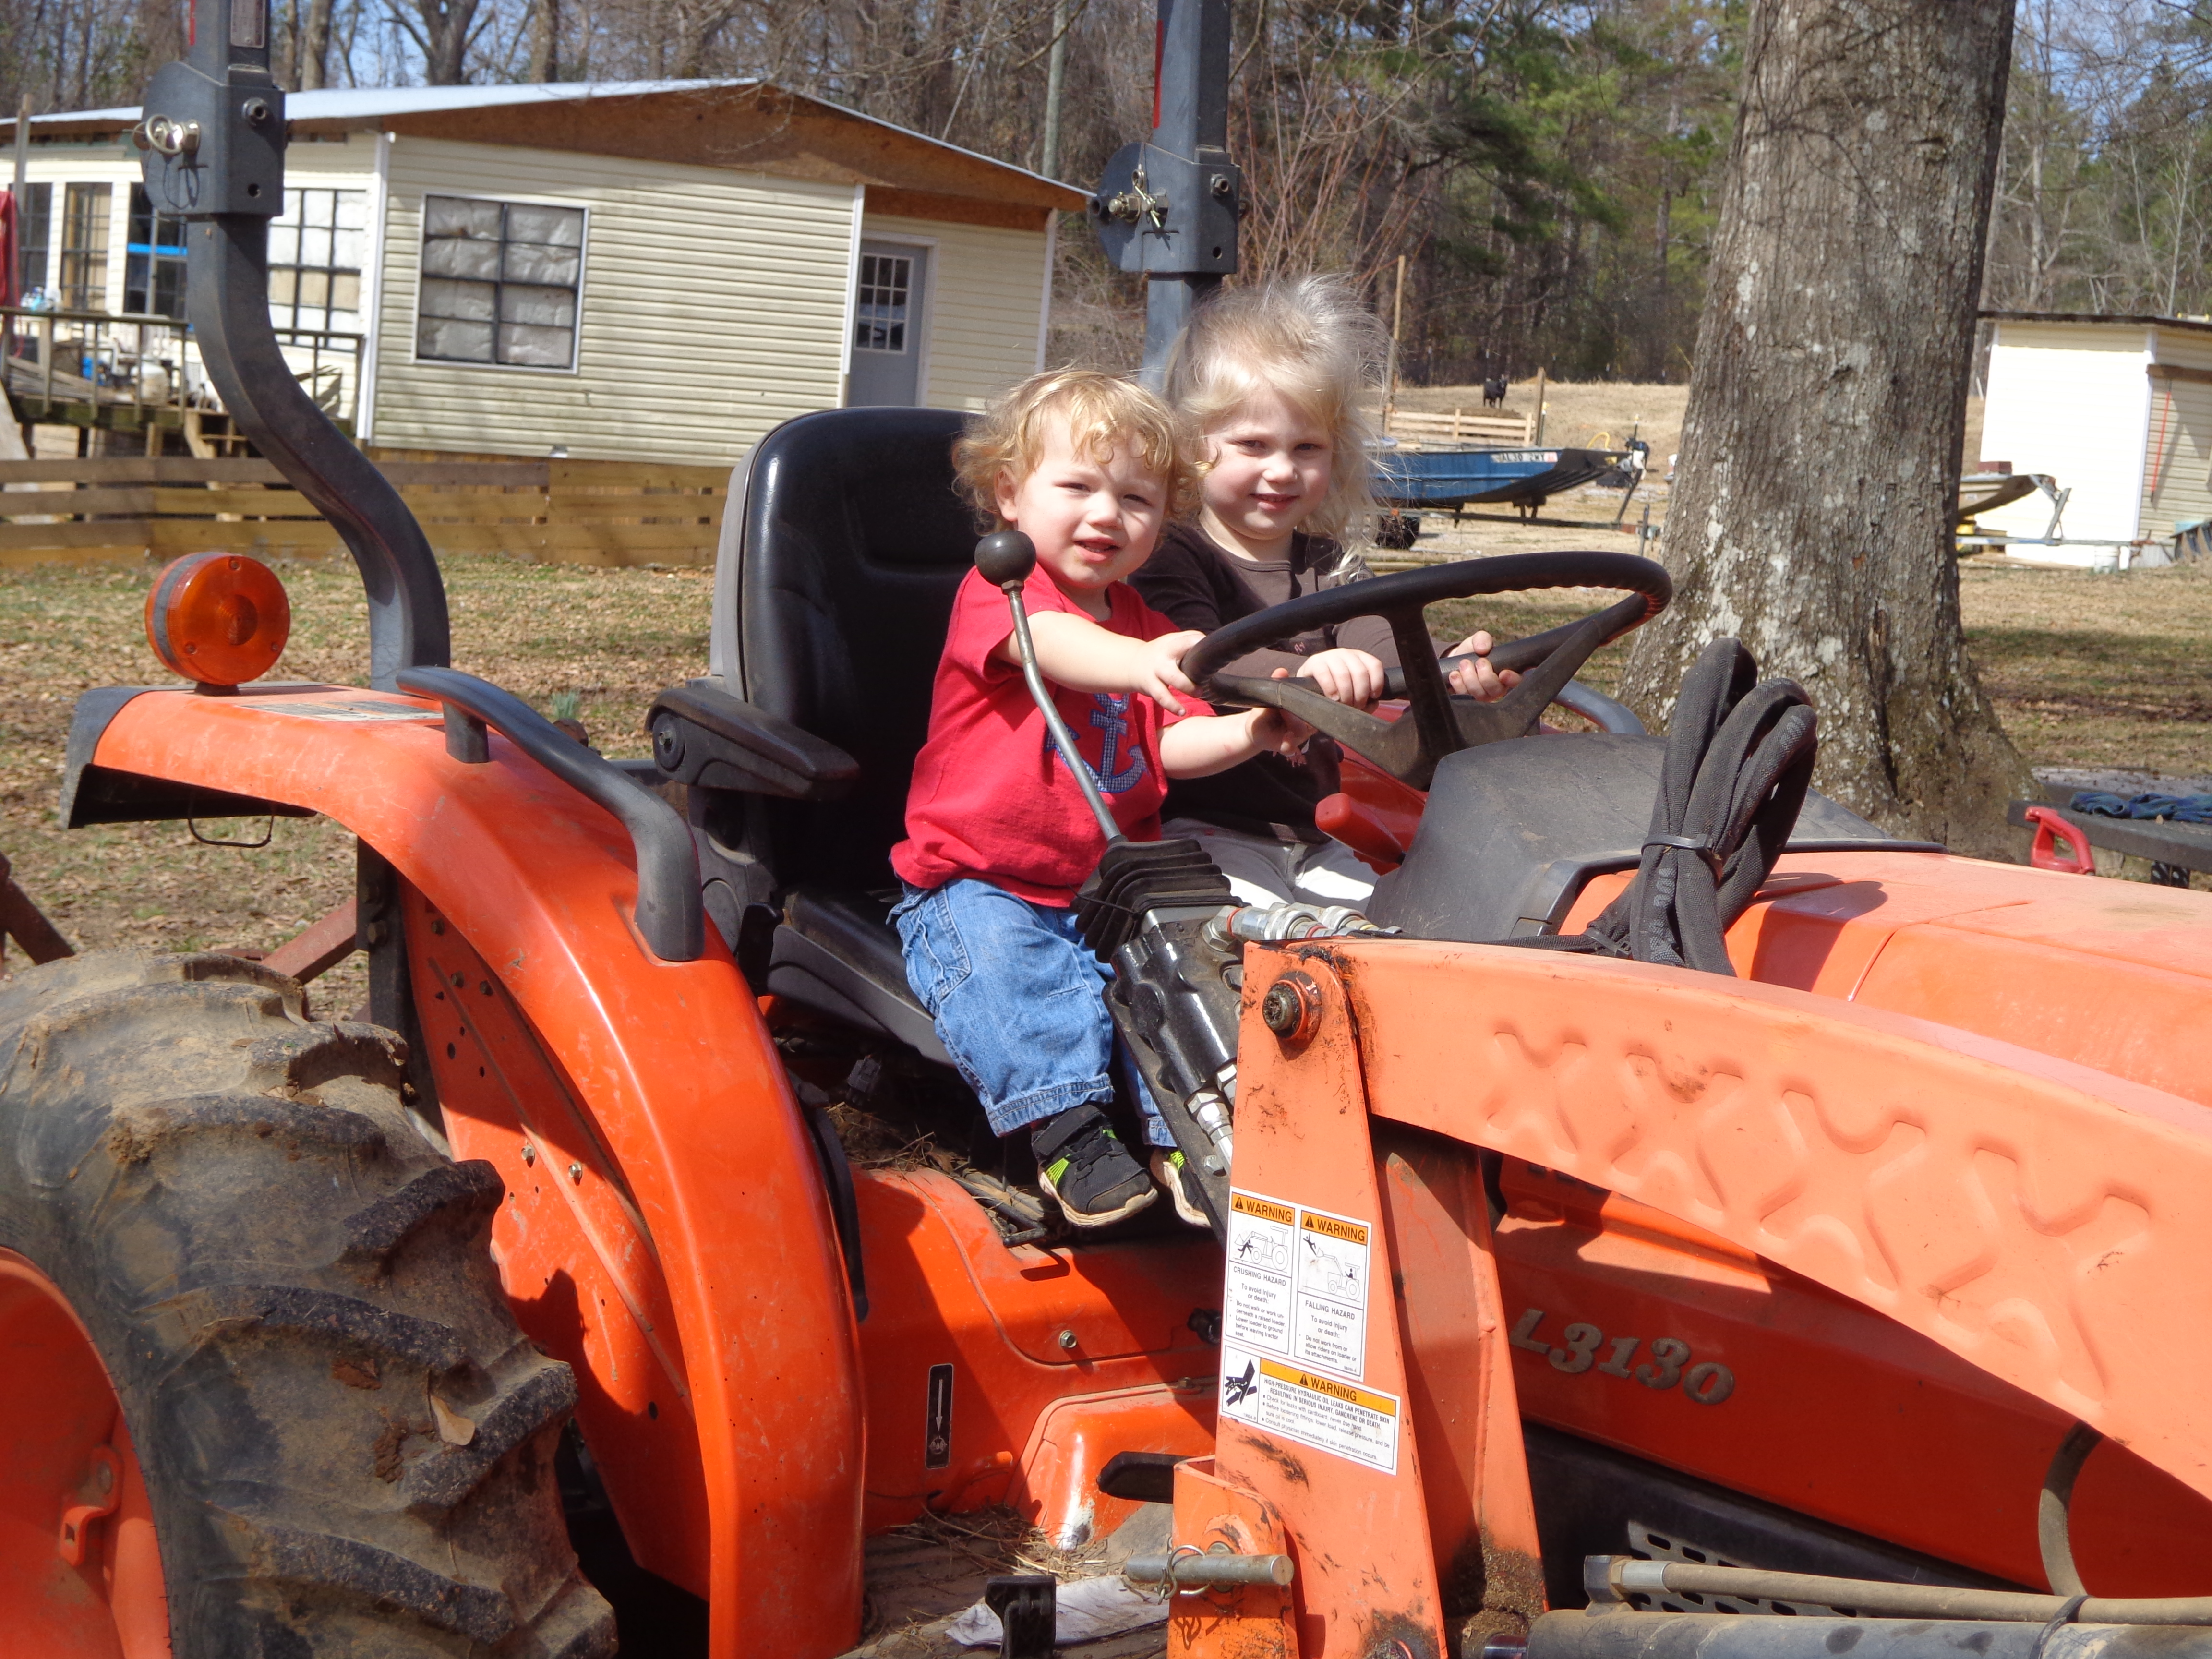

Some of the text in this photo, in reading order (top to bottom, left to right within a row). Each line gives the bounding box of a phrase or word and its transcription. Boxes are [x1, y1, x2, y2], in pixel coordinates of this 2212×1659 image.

[1246, 1200, 1292, 1223] WARNING
[1317, 1218, 1365, 1242] WARNING
[1233, 1266, 1286, 1286] CRUSHING HAZARD
[1254, 1295, 1269, 1304] death:
[1263, 1289, 1276, 1299] injury
[1237, 1309, 1253, 1318] derneath
[1305, 1300, 1355, 1320] FALLING HAZARD
[1249, 1319, 1262, 1327] loader
[1268, 1325, 1283, 1334] ground
[1250, 1327, 1263, 1337] leaving
[1265, 1332, 1278, 1340] tractor
[1324, 1329, 1340, 1338] death:
[1334, 1322, 1347, 1333] injury
[1509, 1308, 1736, 1405] L3130
[1311, 1377, 1357, 1402] WARNING
[1264, 1378, 1296, 1394] HIGH-PRESSURE
[1298, 1389, 1321, 1402] HYDRAULIC
[1331, 1400, 1343, 1408] LEAKS
[1355, 1407, 1378, 1420] PENETRATE
[1380, 1416, 1389, 1424] SKIN
[1267, 1403, 1279, 1411] Before
[1270, 1388, 1291, 1400] RESULTING
[1299, 1397, 1316, 1408] SERIOUS
[1318, 1404, 1334, 1414] INJURY,
[1335, 1409, 1358, 1421] GANGRENE
[1266, 1418, 1280, 1427] Consult
